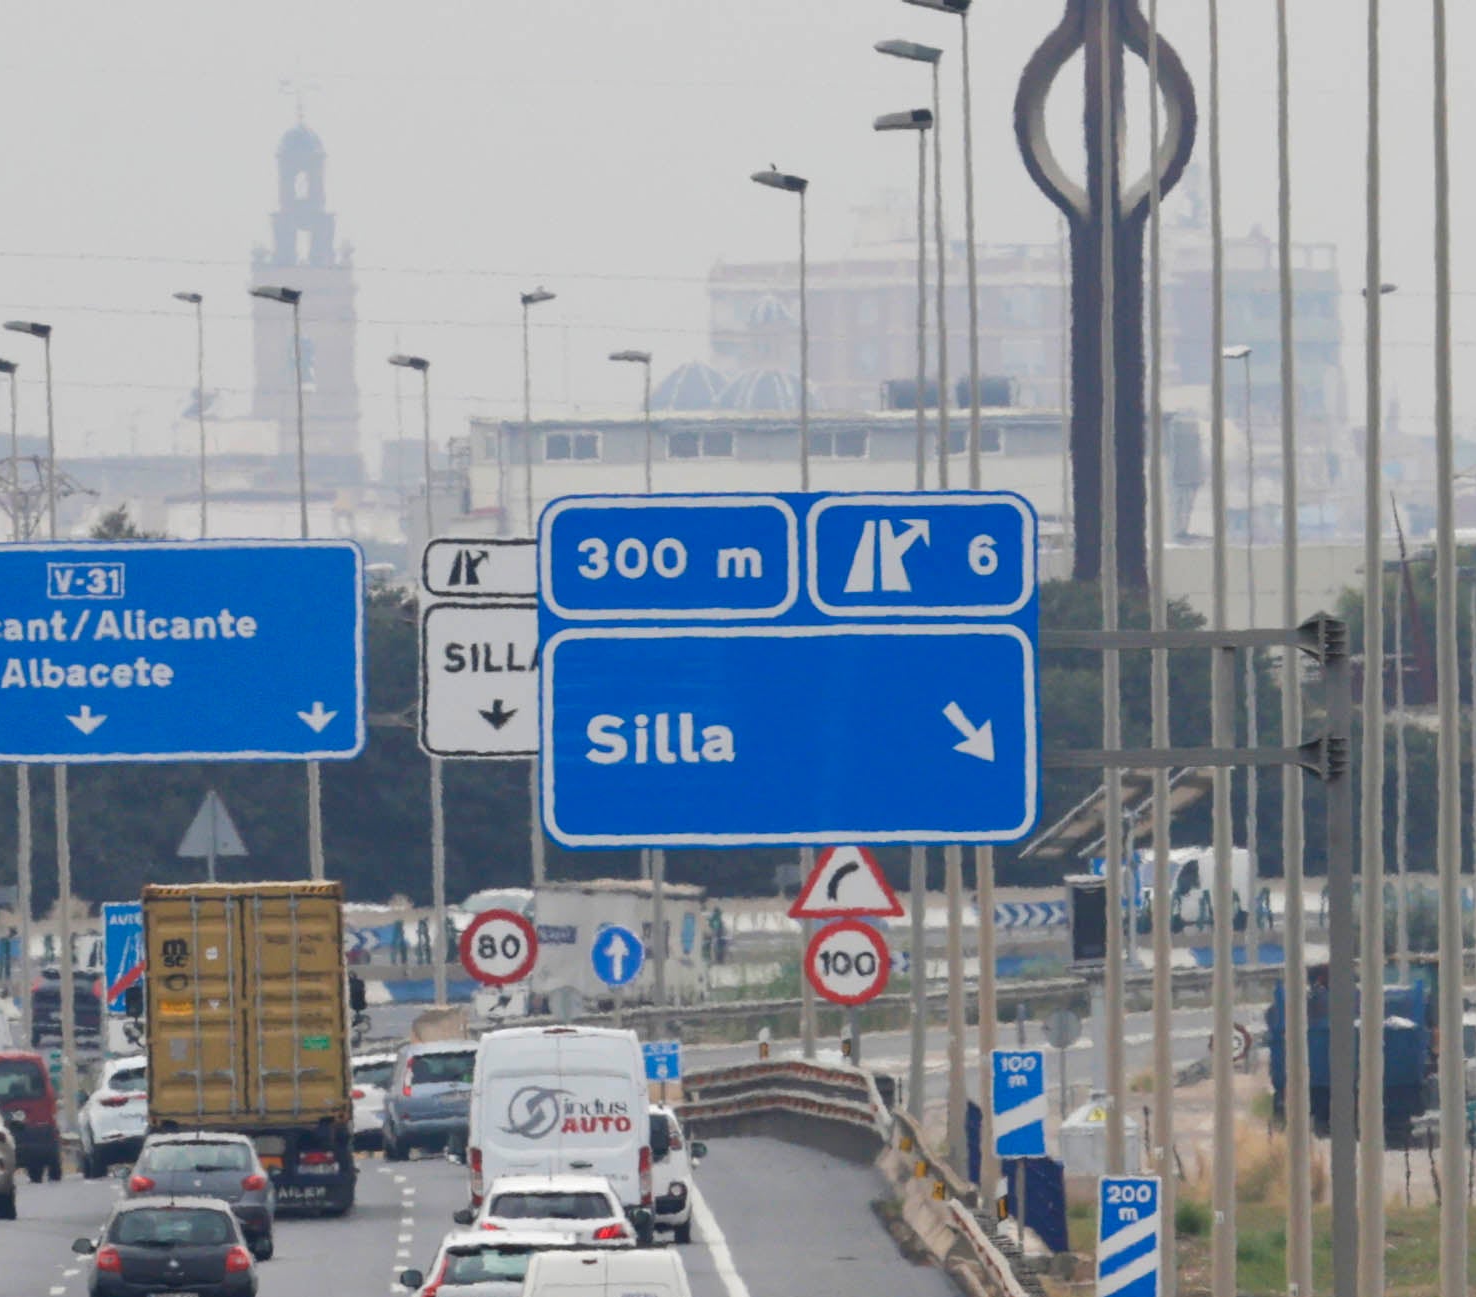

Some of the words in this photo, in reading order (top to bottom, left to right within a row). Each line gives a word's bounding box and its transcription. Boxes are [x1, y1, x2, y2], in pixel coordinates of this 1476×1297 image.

[576, 536, 688, 580] 300
[716, 544, 764, 580] m
[966, 534, 999, 576] 6
[53, 568, 121, 595] V-31
[0, 657, 175, 690] Albacete
[584, 711, 737, 764] Silla
[477, 934, 521, 960] 80
[819, 950, 877, 978] 100
[999, 1055, 1037, 1073] 100
[1007, 1074, 1029, 1088] m
[561, 1116, 632, 1134] AUTO
[1106, 1184, 1152, 1203] 200
[1117, 1207, 1139, 1221] m
